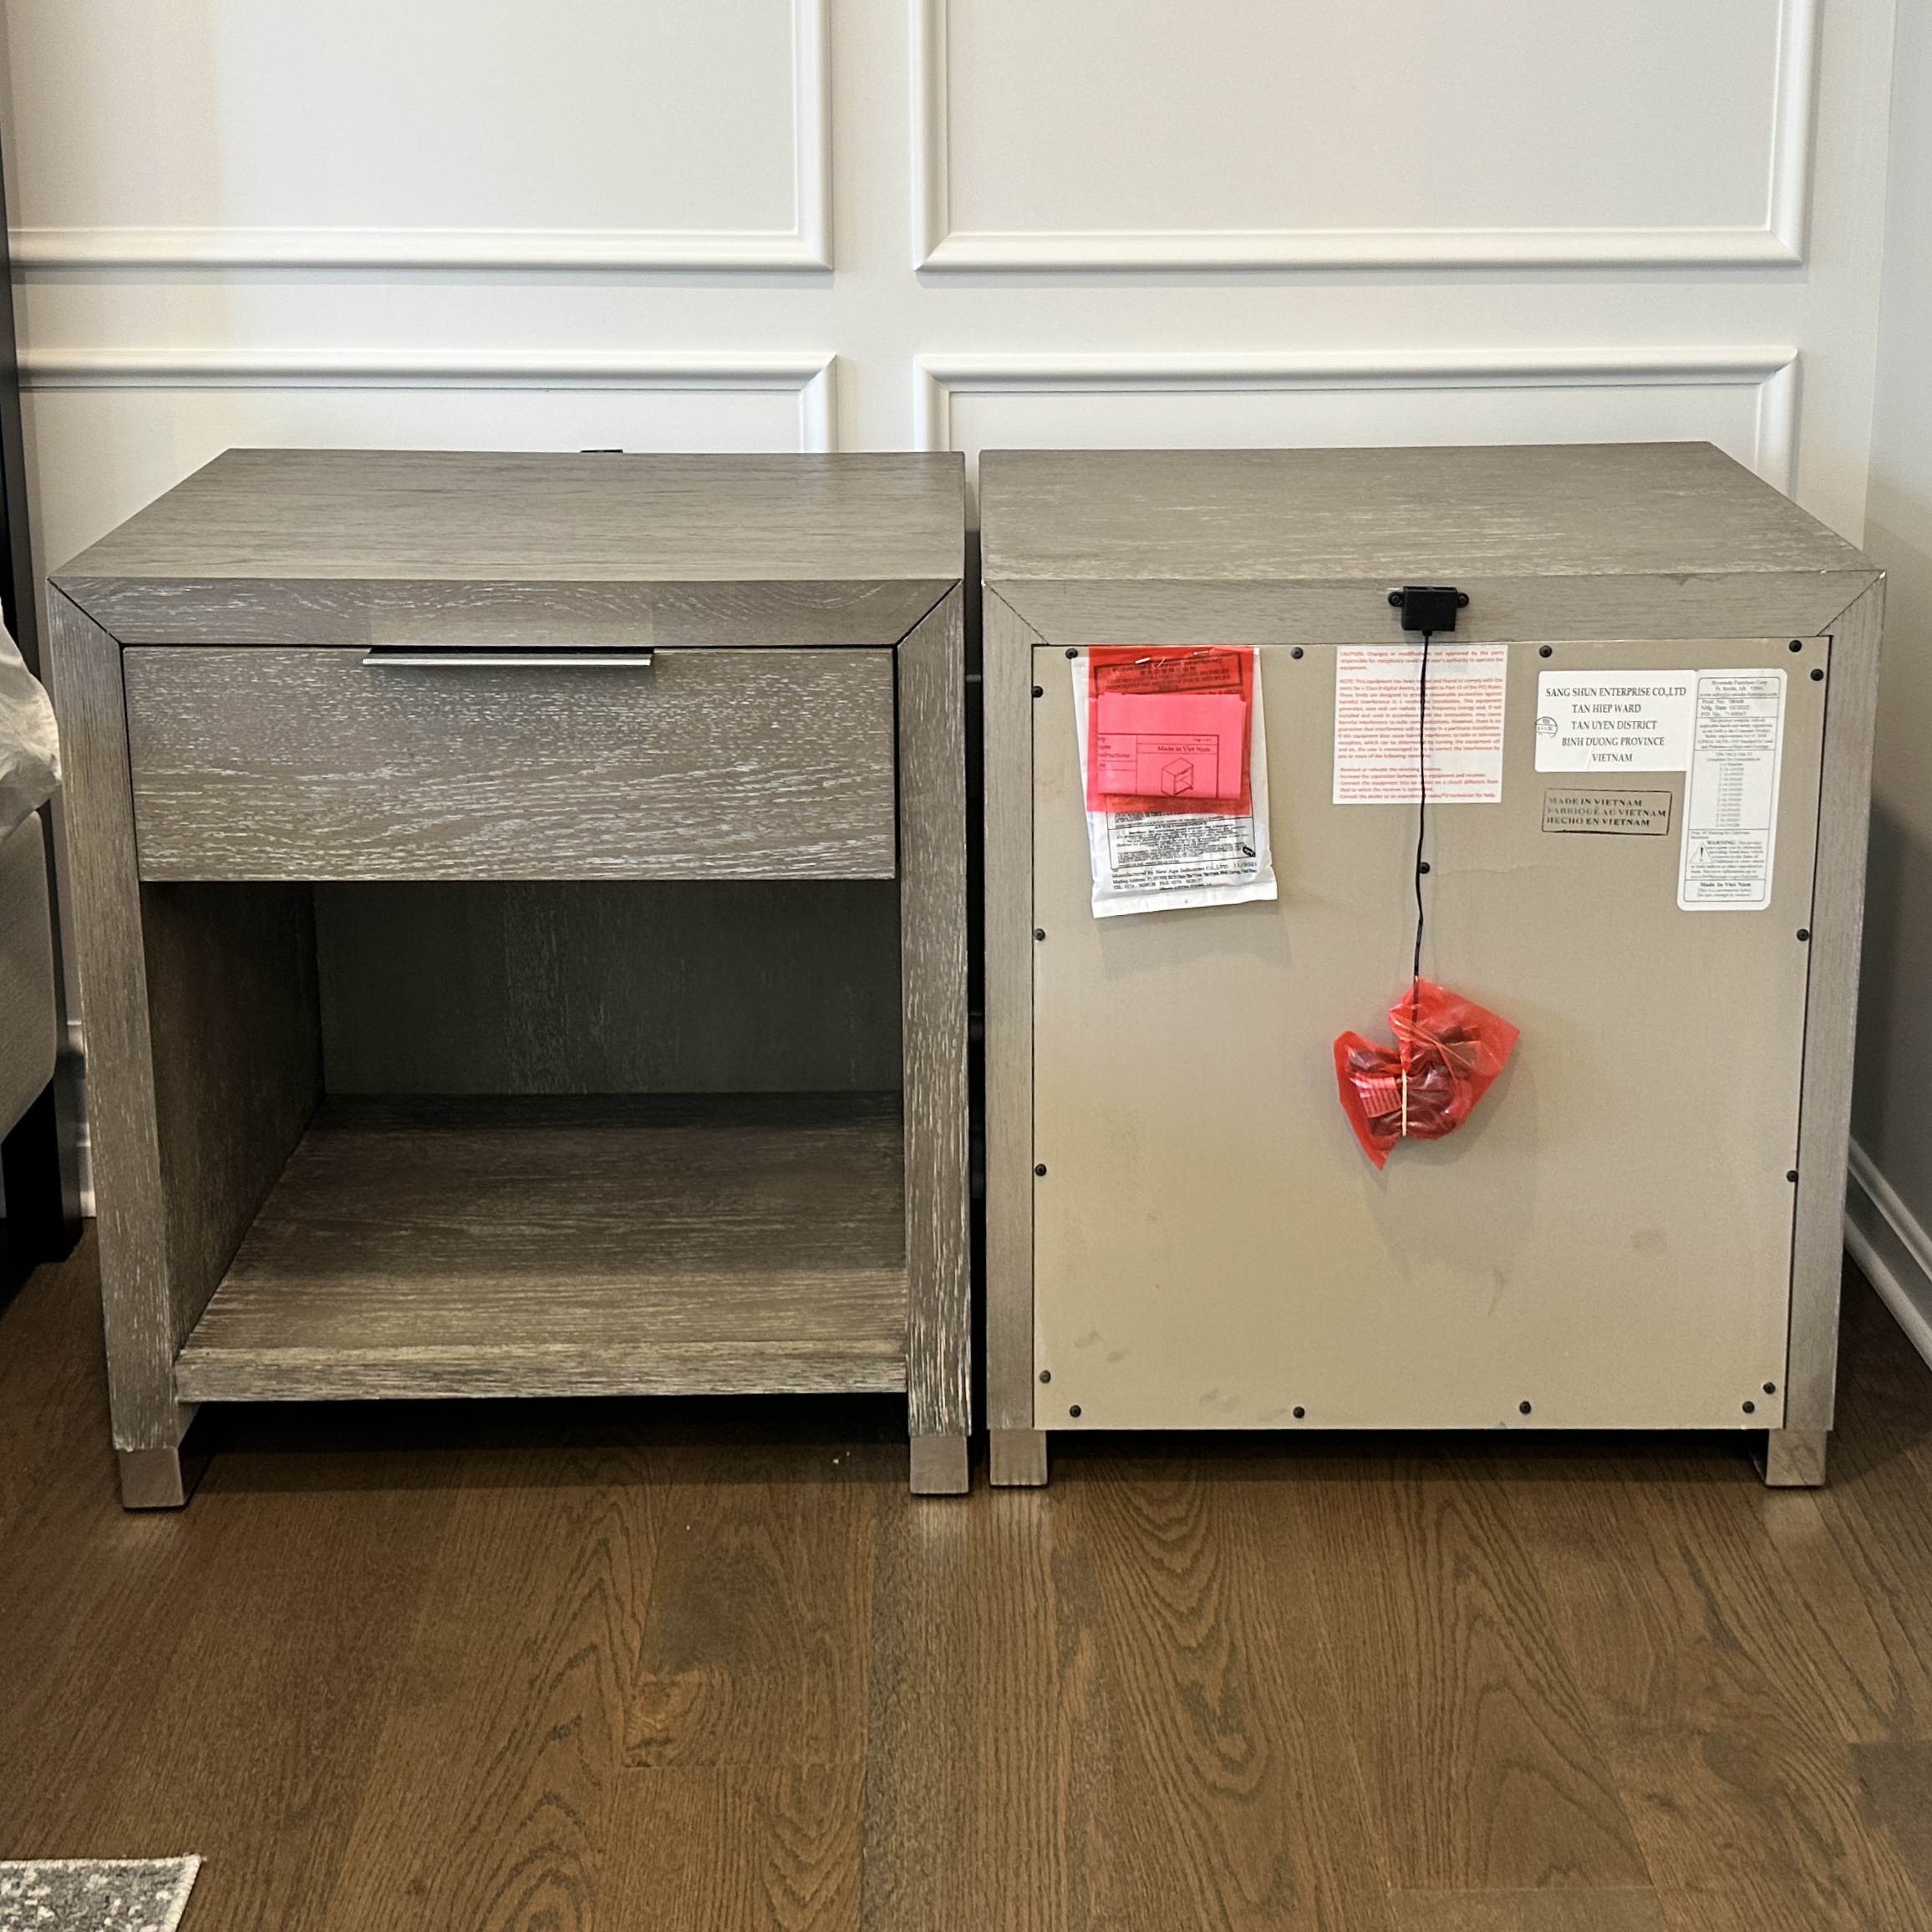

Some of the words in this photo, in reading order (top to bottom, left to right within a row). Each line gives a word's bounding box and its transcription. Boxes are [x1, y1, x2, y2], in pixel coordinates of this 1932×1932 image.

[1546, 688, 1570, 697] SANG
[1572, 688, 1598, 697] SHUN
[1599, 687, 1651, 697] ENTERPRISE
[1572, 704, 1591, 713] TAN
[1593, 704, 1613, 713] HIEP
[1614, 704, 1641, 713] WARD
[1571, 721, 1589, 730] TAN
[1592, 721, 1614, 730] UYEN
[1617, 720, 1657, 730] DISTRICT
[1562, 737, 1583, 746] BINH
[1586, 737, 1619, 746] DUONG
[1620, 737, 1665, 746] PROVINCE
[1592, 753, 1633, 762] VIETNAM
